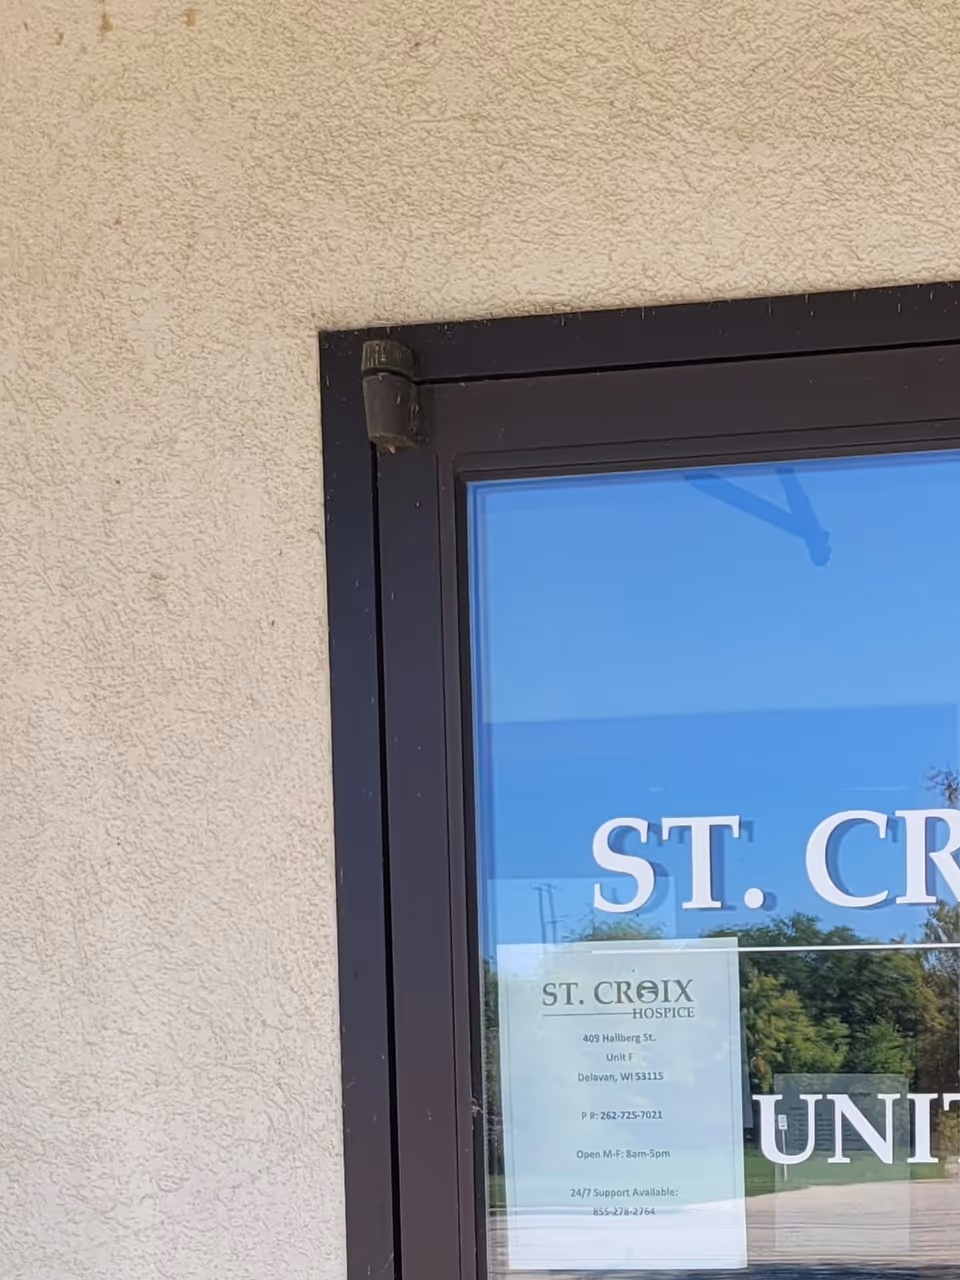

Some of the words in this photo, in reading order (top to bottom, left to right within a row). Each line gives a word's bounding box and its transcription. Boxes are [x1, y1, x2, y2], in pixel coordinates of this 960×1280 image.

[592, 815, 764, 913] ST.
[542, 982, 585, 1007] ST.
[593, 978, 694, 1005] CROIX
[632, 1006, 695, 1020] HOSPICE
[582, 1032, 600, 1044] 409
[602, 1032, 641, 1045] Hallberg
[643, 1032, 657, 1043] St.
[606, 1052, 626, 1063] Unit
[628, 1052, 634, 1062] F
[577, 1072, 618, 1084] Delavan,
[620, 1072, 634, 1082] WI
[635, 1071, 664, 1082] 53115
[581, 1111, 588, 1121] P
[600, 1109, 663, 1121] 262-725-7021
[576, 1149, 601, 1161] Open
[603, 1149, 625, 1160] M-F:
[626, 1148, 671, 1161] 8am-5pm
[570, 1187, 592, 1199] 24/7
[593, 1187, 631, 1200] Support
[632, 1187, 679, 1198] Available:
[592, 1206, 656, 1217] 855-278-2764
